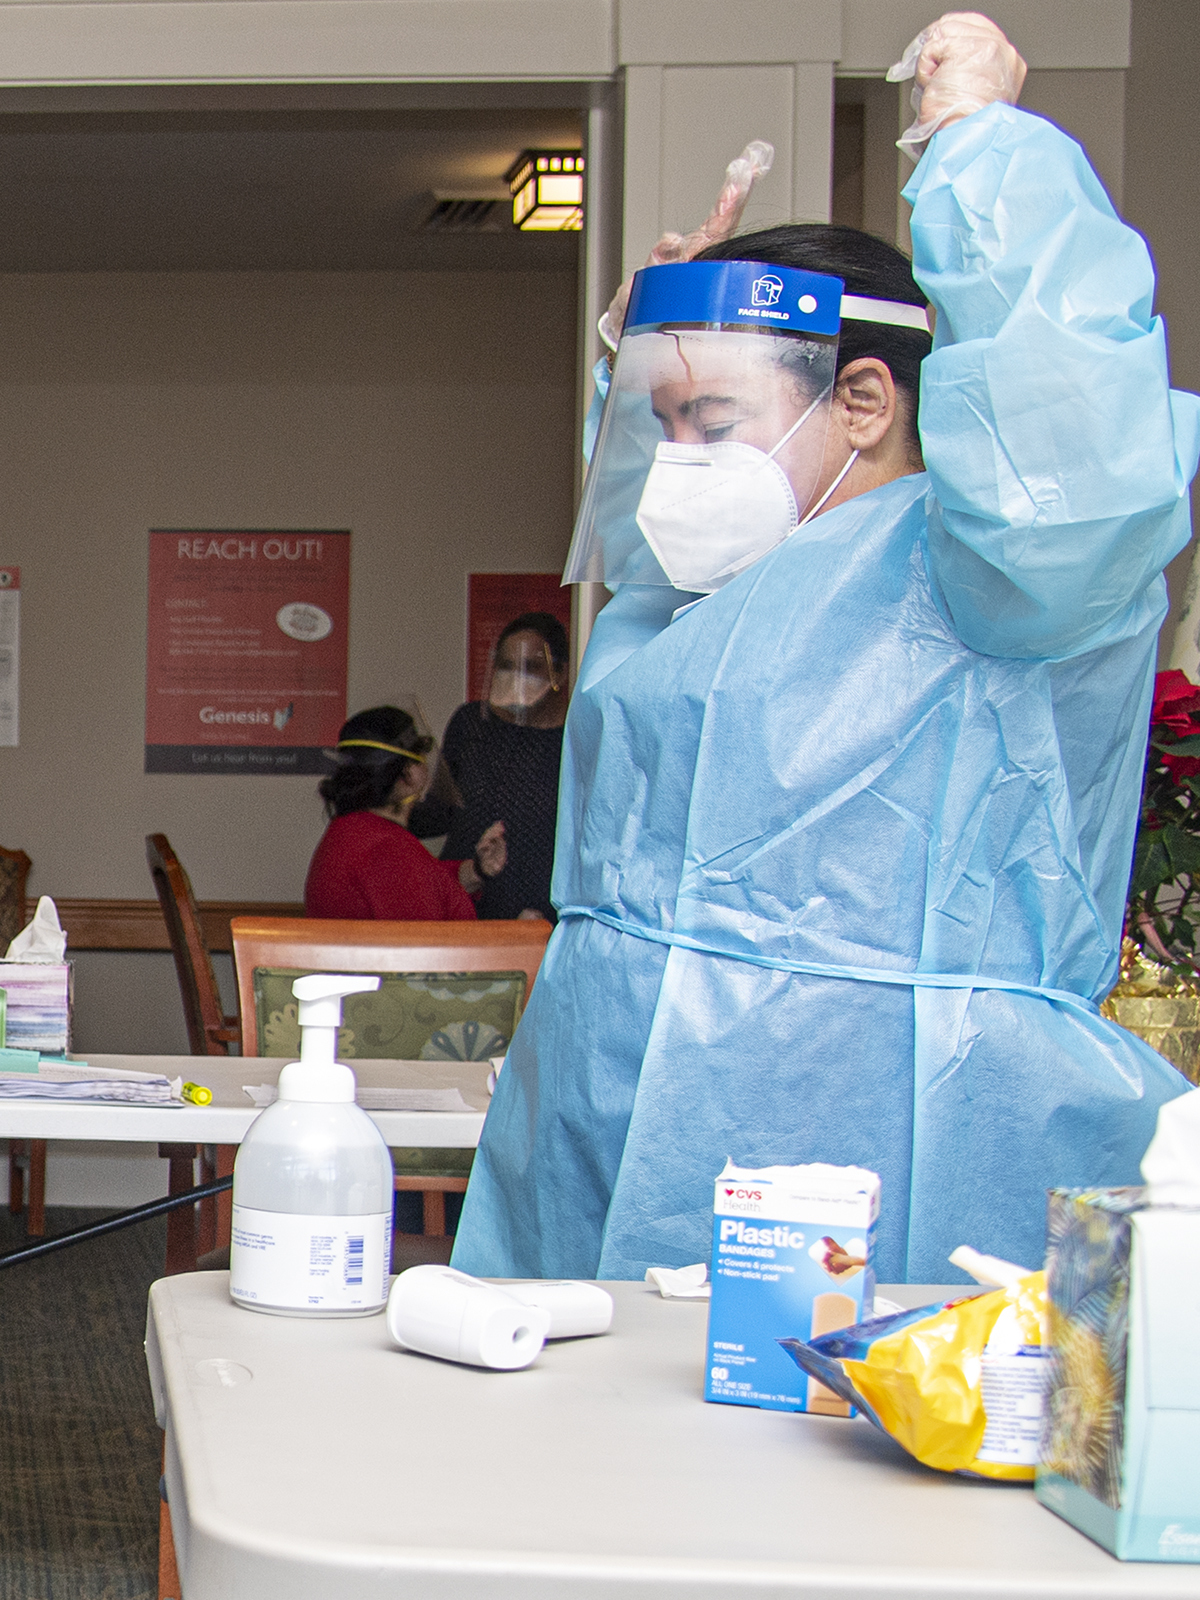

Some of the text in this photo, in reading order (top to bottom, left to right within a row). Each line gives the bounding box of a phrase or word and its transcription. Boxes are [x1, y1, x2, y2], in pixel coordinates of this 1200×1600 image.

[738, 308, 790, 320] FACE SHIELD
[178, 539, 322, 561] REACH OUT!
[199, 706, 270, 724] Genesis
[192, 753, 208, 764] Let
[211, 755, 222, 764] us
[223, 753, 245, 764] hear
[249, 753, 273, 764] from
[736, 1188, 762, 1200] CVS
[724, 1199, 761, 1212] Health
[720, 1219, 806, 1249] Plastic
[719, 1244, 776, 1259] BANDAGES
[724, 1258, 795, 1274] Covers & protects
[723, 1269, 779, 1282] Non-stick pad
[714, 1341, 744, 1352] STERILE
[711, 1366, 729, 1380] 60
[711, 1380, 752, 1391] ALL ONE SIZE
[748, 1391, 758, 1399] (19
